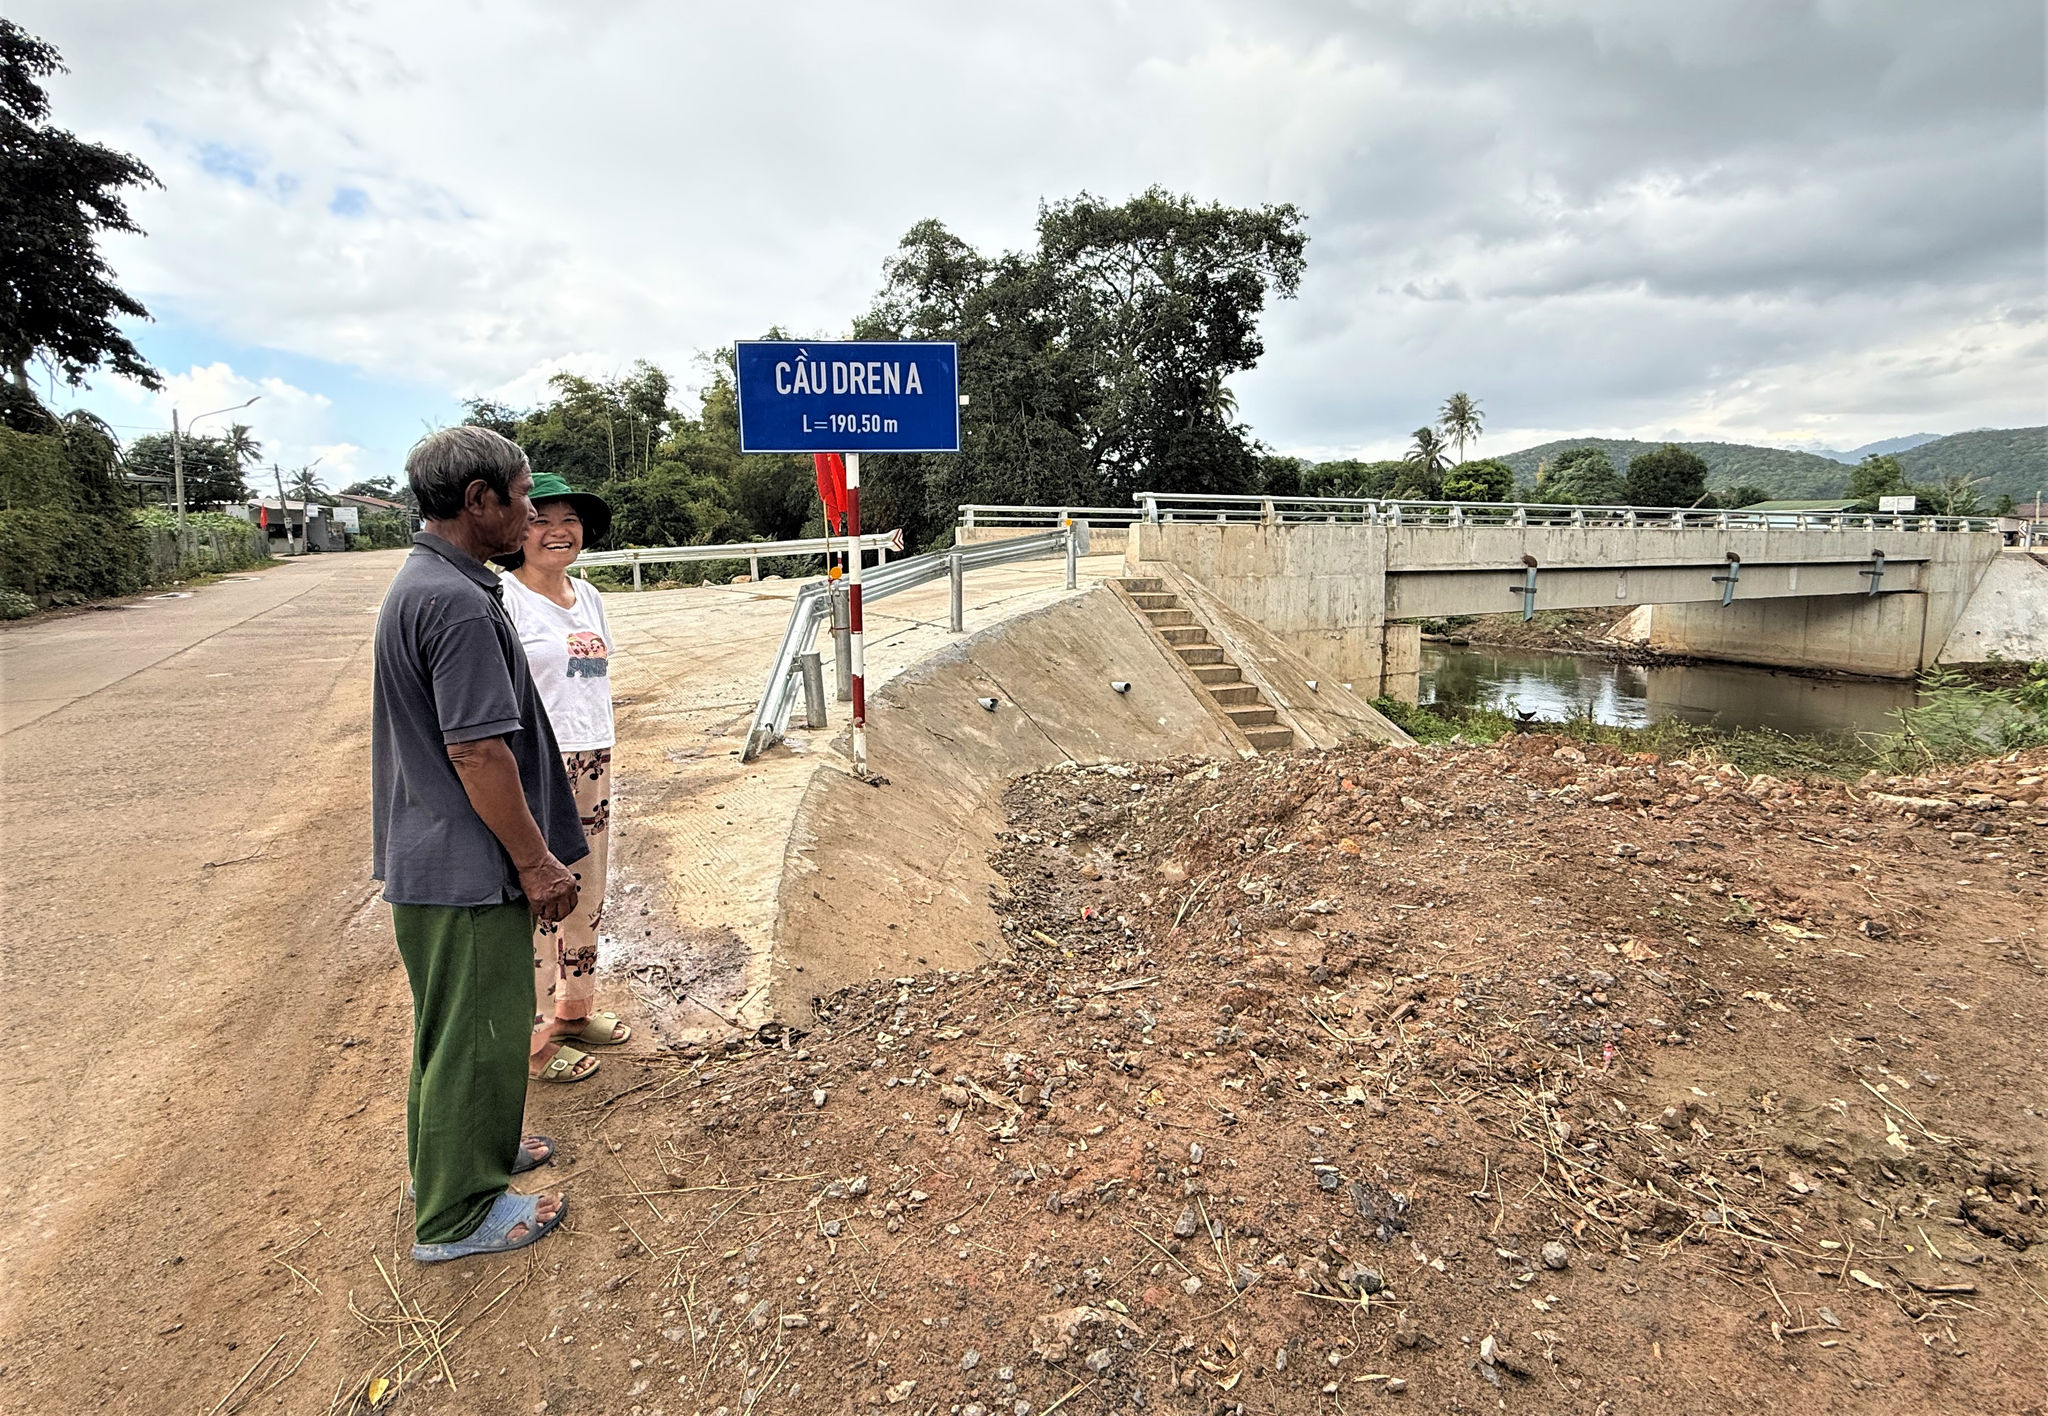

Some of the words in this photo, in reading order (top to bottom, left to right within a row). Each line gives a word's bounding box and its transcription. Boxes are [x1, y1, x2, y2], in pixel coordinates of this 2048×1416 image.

[775, 348, 827, 395] CẦU
[832, 361, 901, 395] DREN
[905, 362, 923, 395] A
[803, 414, 881, 434] L=190,50
[885, 419, 898, 433] m
